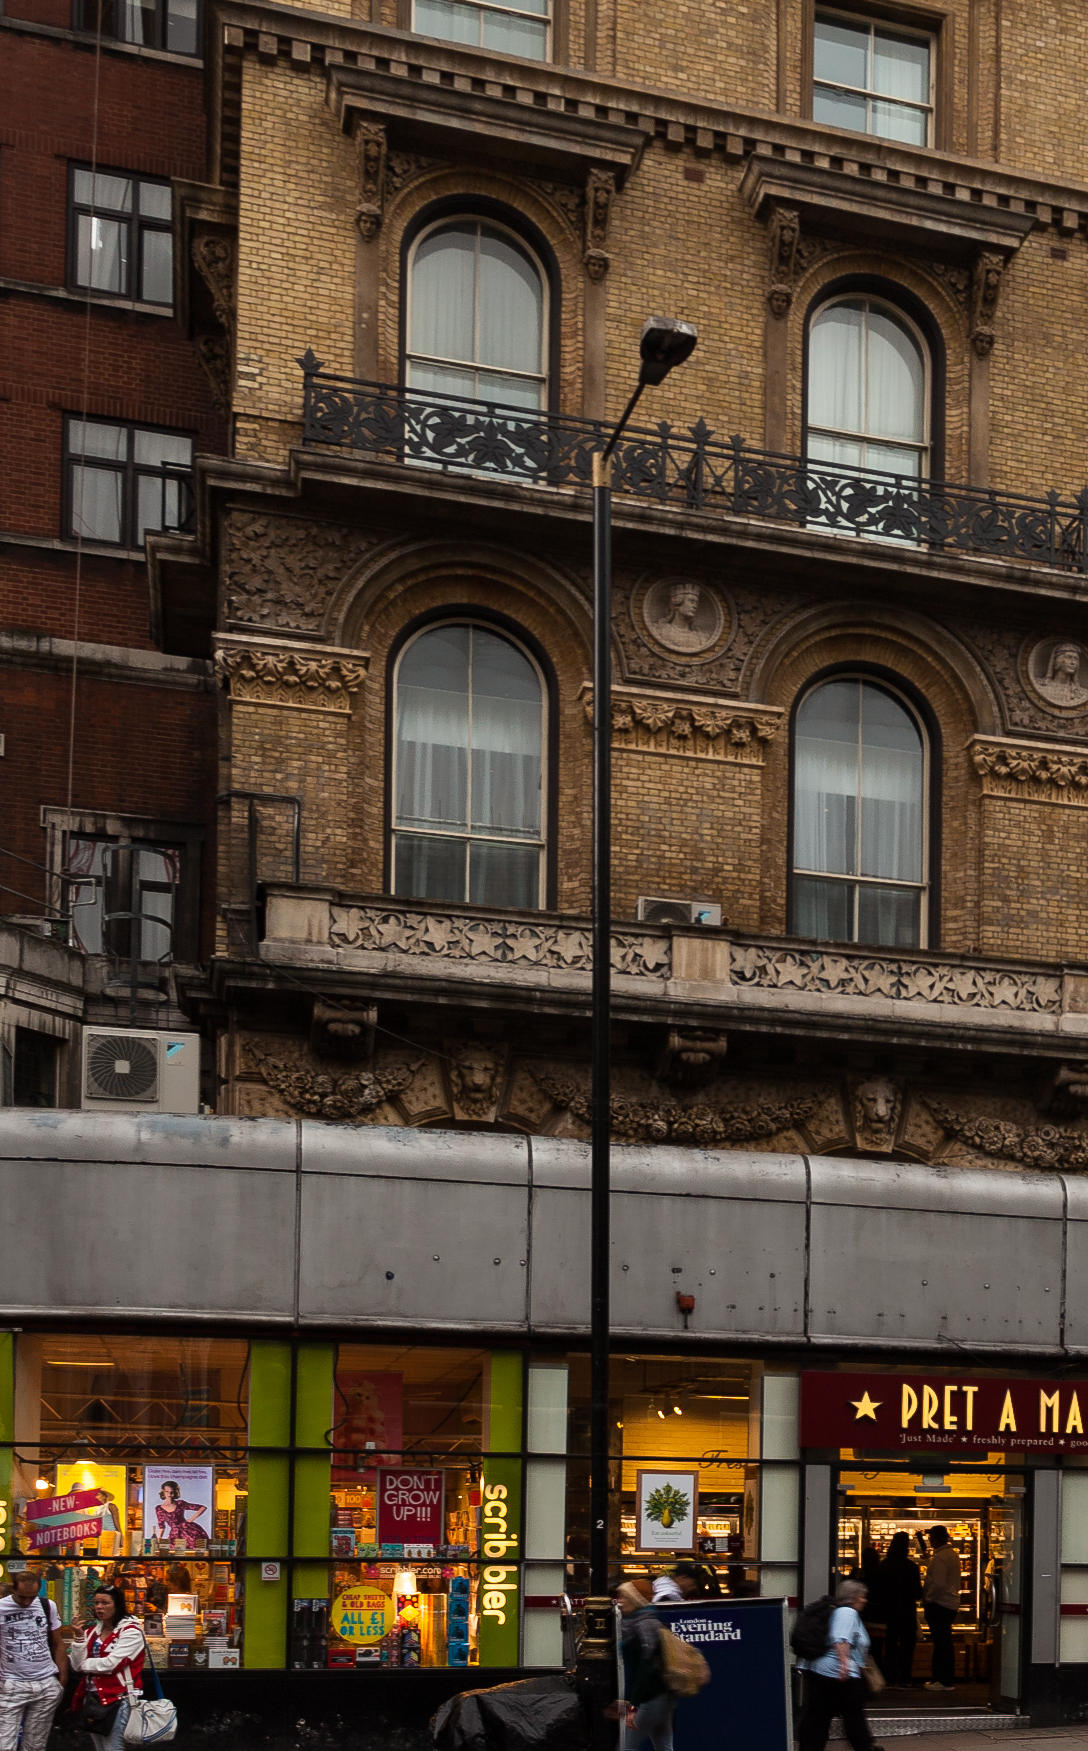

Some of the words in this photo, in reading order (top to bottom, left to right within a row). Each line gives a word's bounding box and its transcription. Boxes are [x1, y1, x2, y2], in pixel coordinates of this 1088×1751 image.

[902, 1383, 978, 1430] PRET
[998, 1388, 1017, 1432] A
[973, 1435, 1006, 1446] freshly
[1010, 1437, 1054, 1447] prepared
[385, 1475, 439, 1489] DON'T
[384, 1491, 440, 1505] GROW
[393, 1506, 431, 1522] UP!!!
[596, 1519, 604, 1529] 2
[35, 1521, 98, 1546] NOTEBOOKS
[483, 1484, 518, 1625] scribbler
[340, 1611, 364, 1624] ALL
[370, 1611, 386, 1624] £1
[340, 1625, 355, 1636] OR
[359, 1625, 386, 1636] LESS
[670, 1620, 733, 1633] Evening
